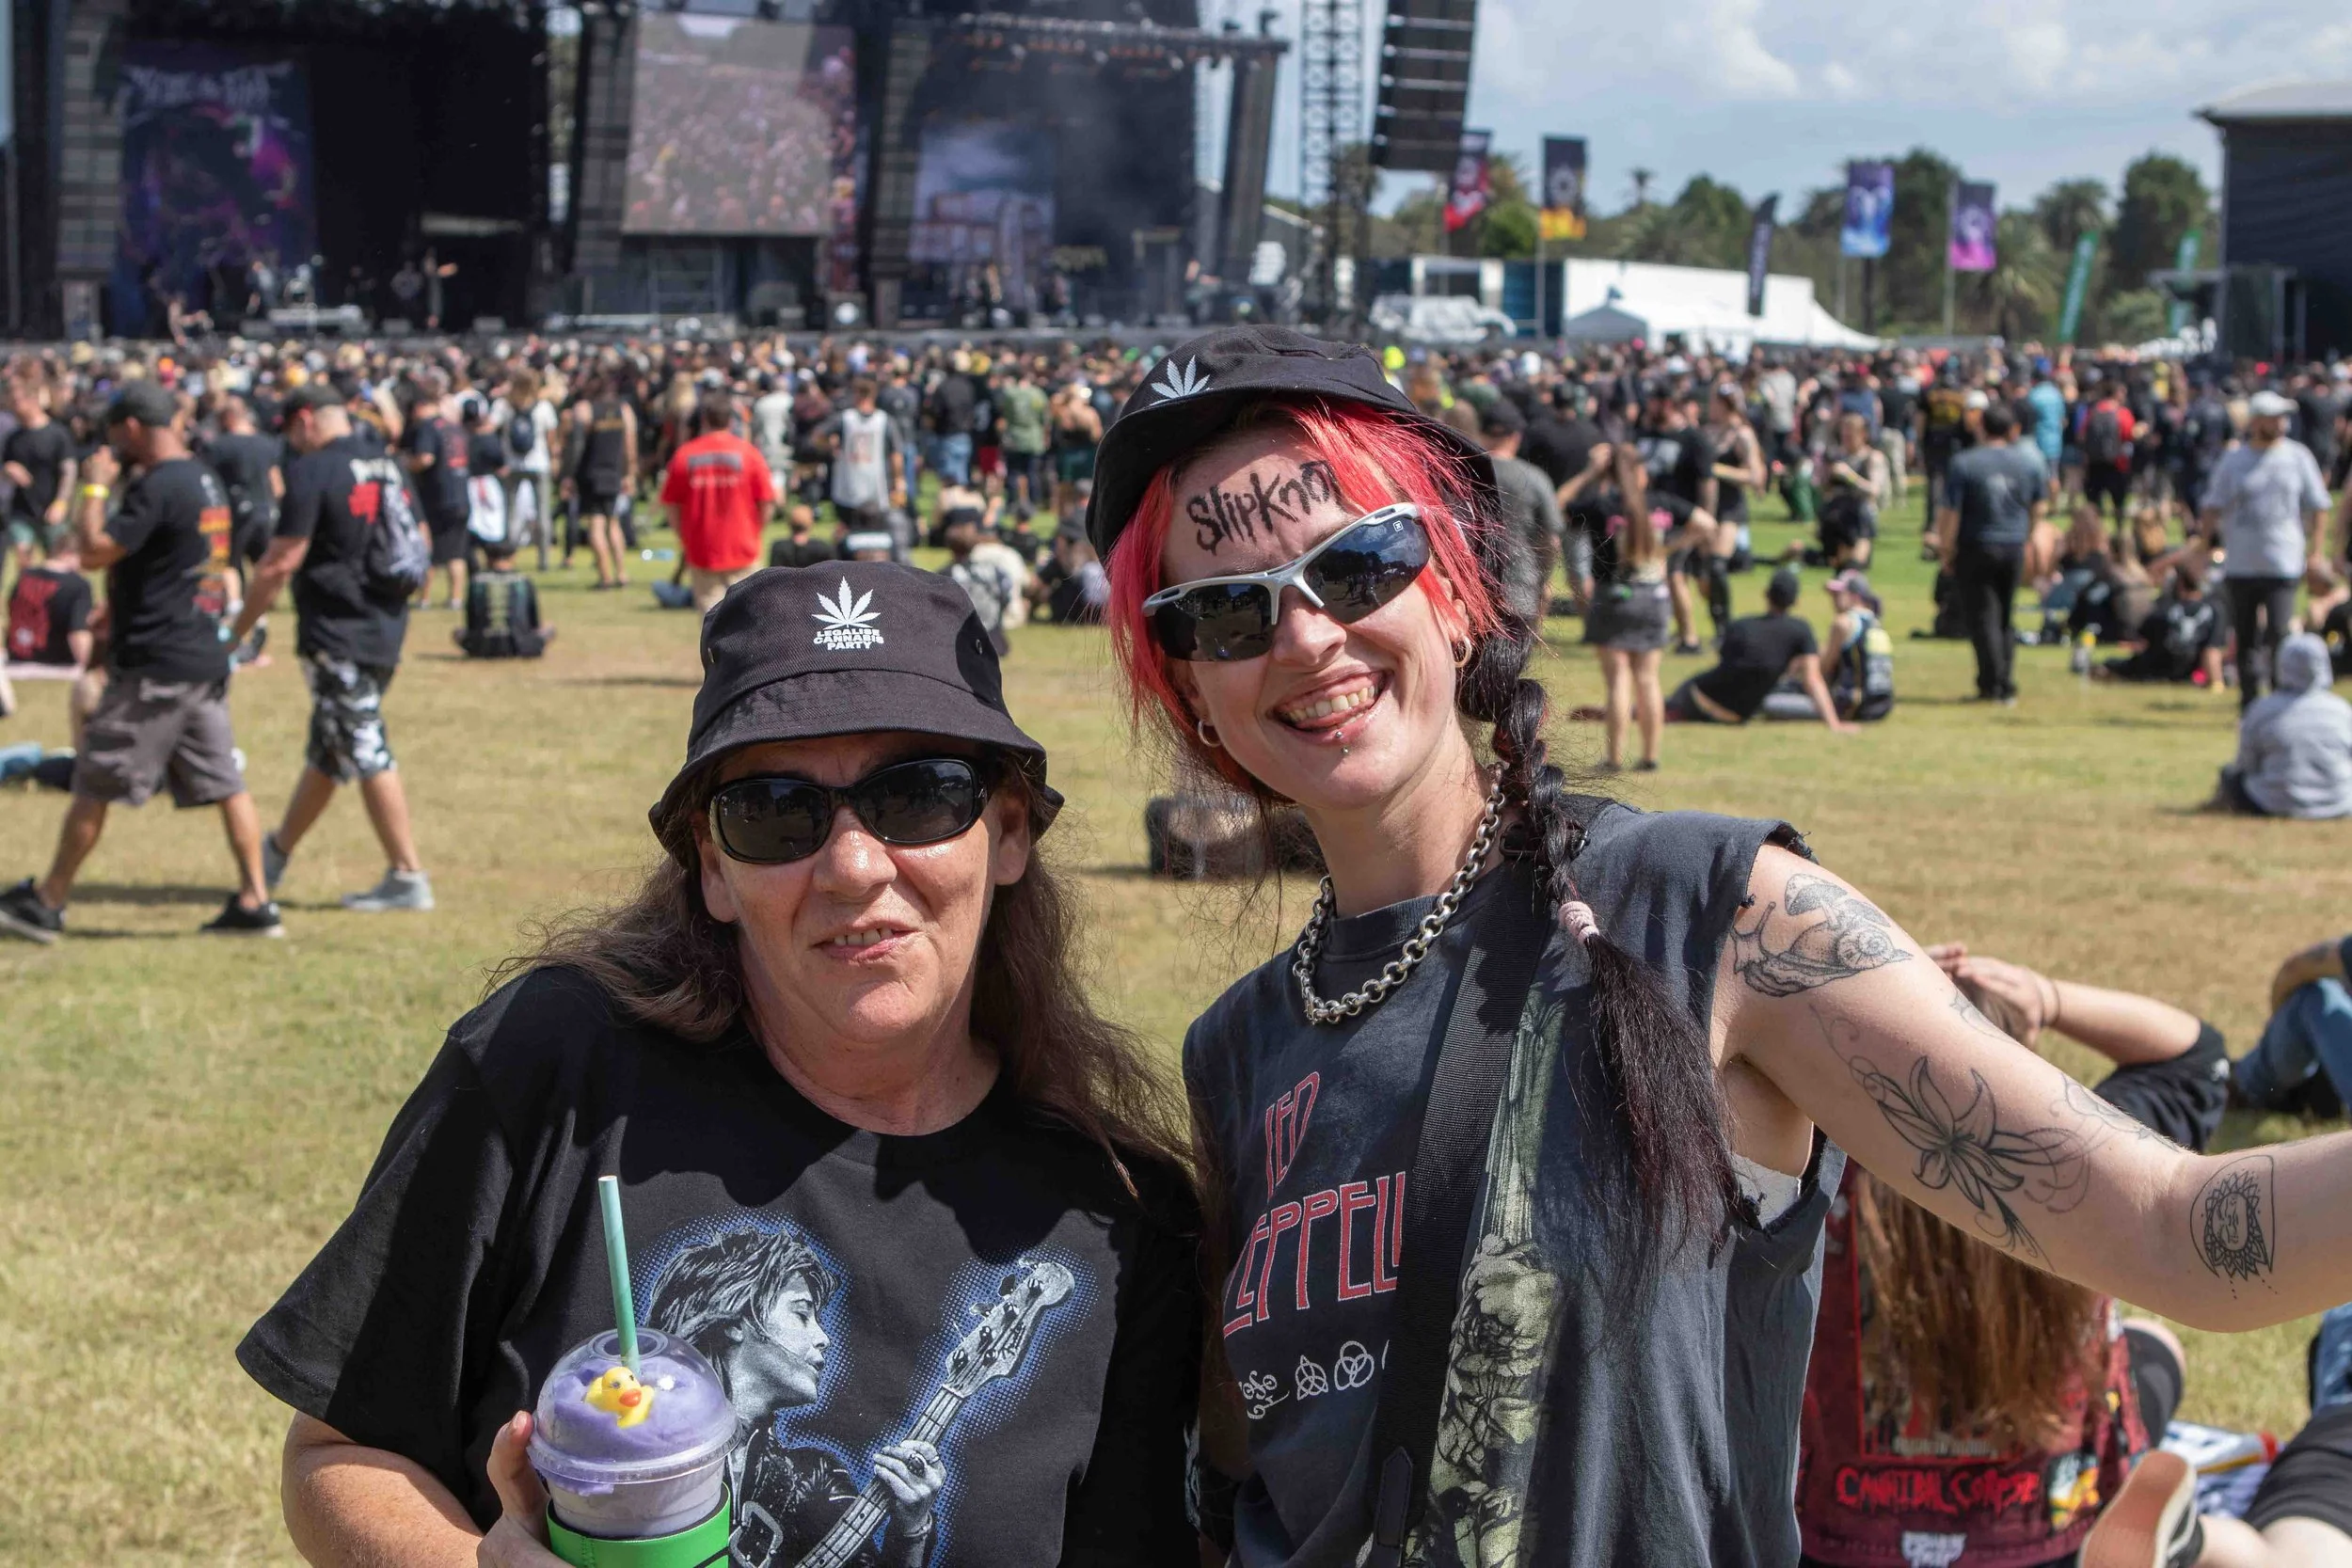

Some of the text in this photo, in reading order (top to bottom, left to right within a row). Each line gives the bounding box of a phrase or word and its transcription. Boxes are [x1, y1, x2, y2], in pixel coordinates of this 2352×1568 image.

[817, 628, 881, 637] LEGALISE
[813, 634, 884, 644] CANNABIS
[827, 641, 873, 650] PARTY
